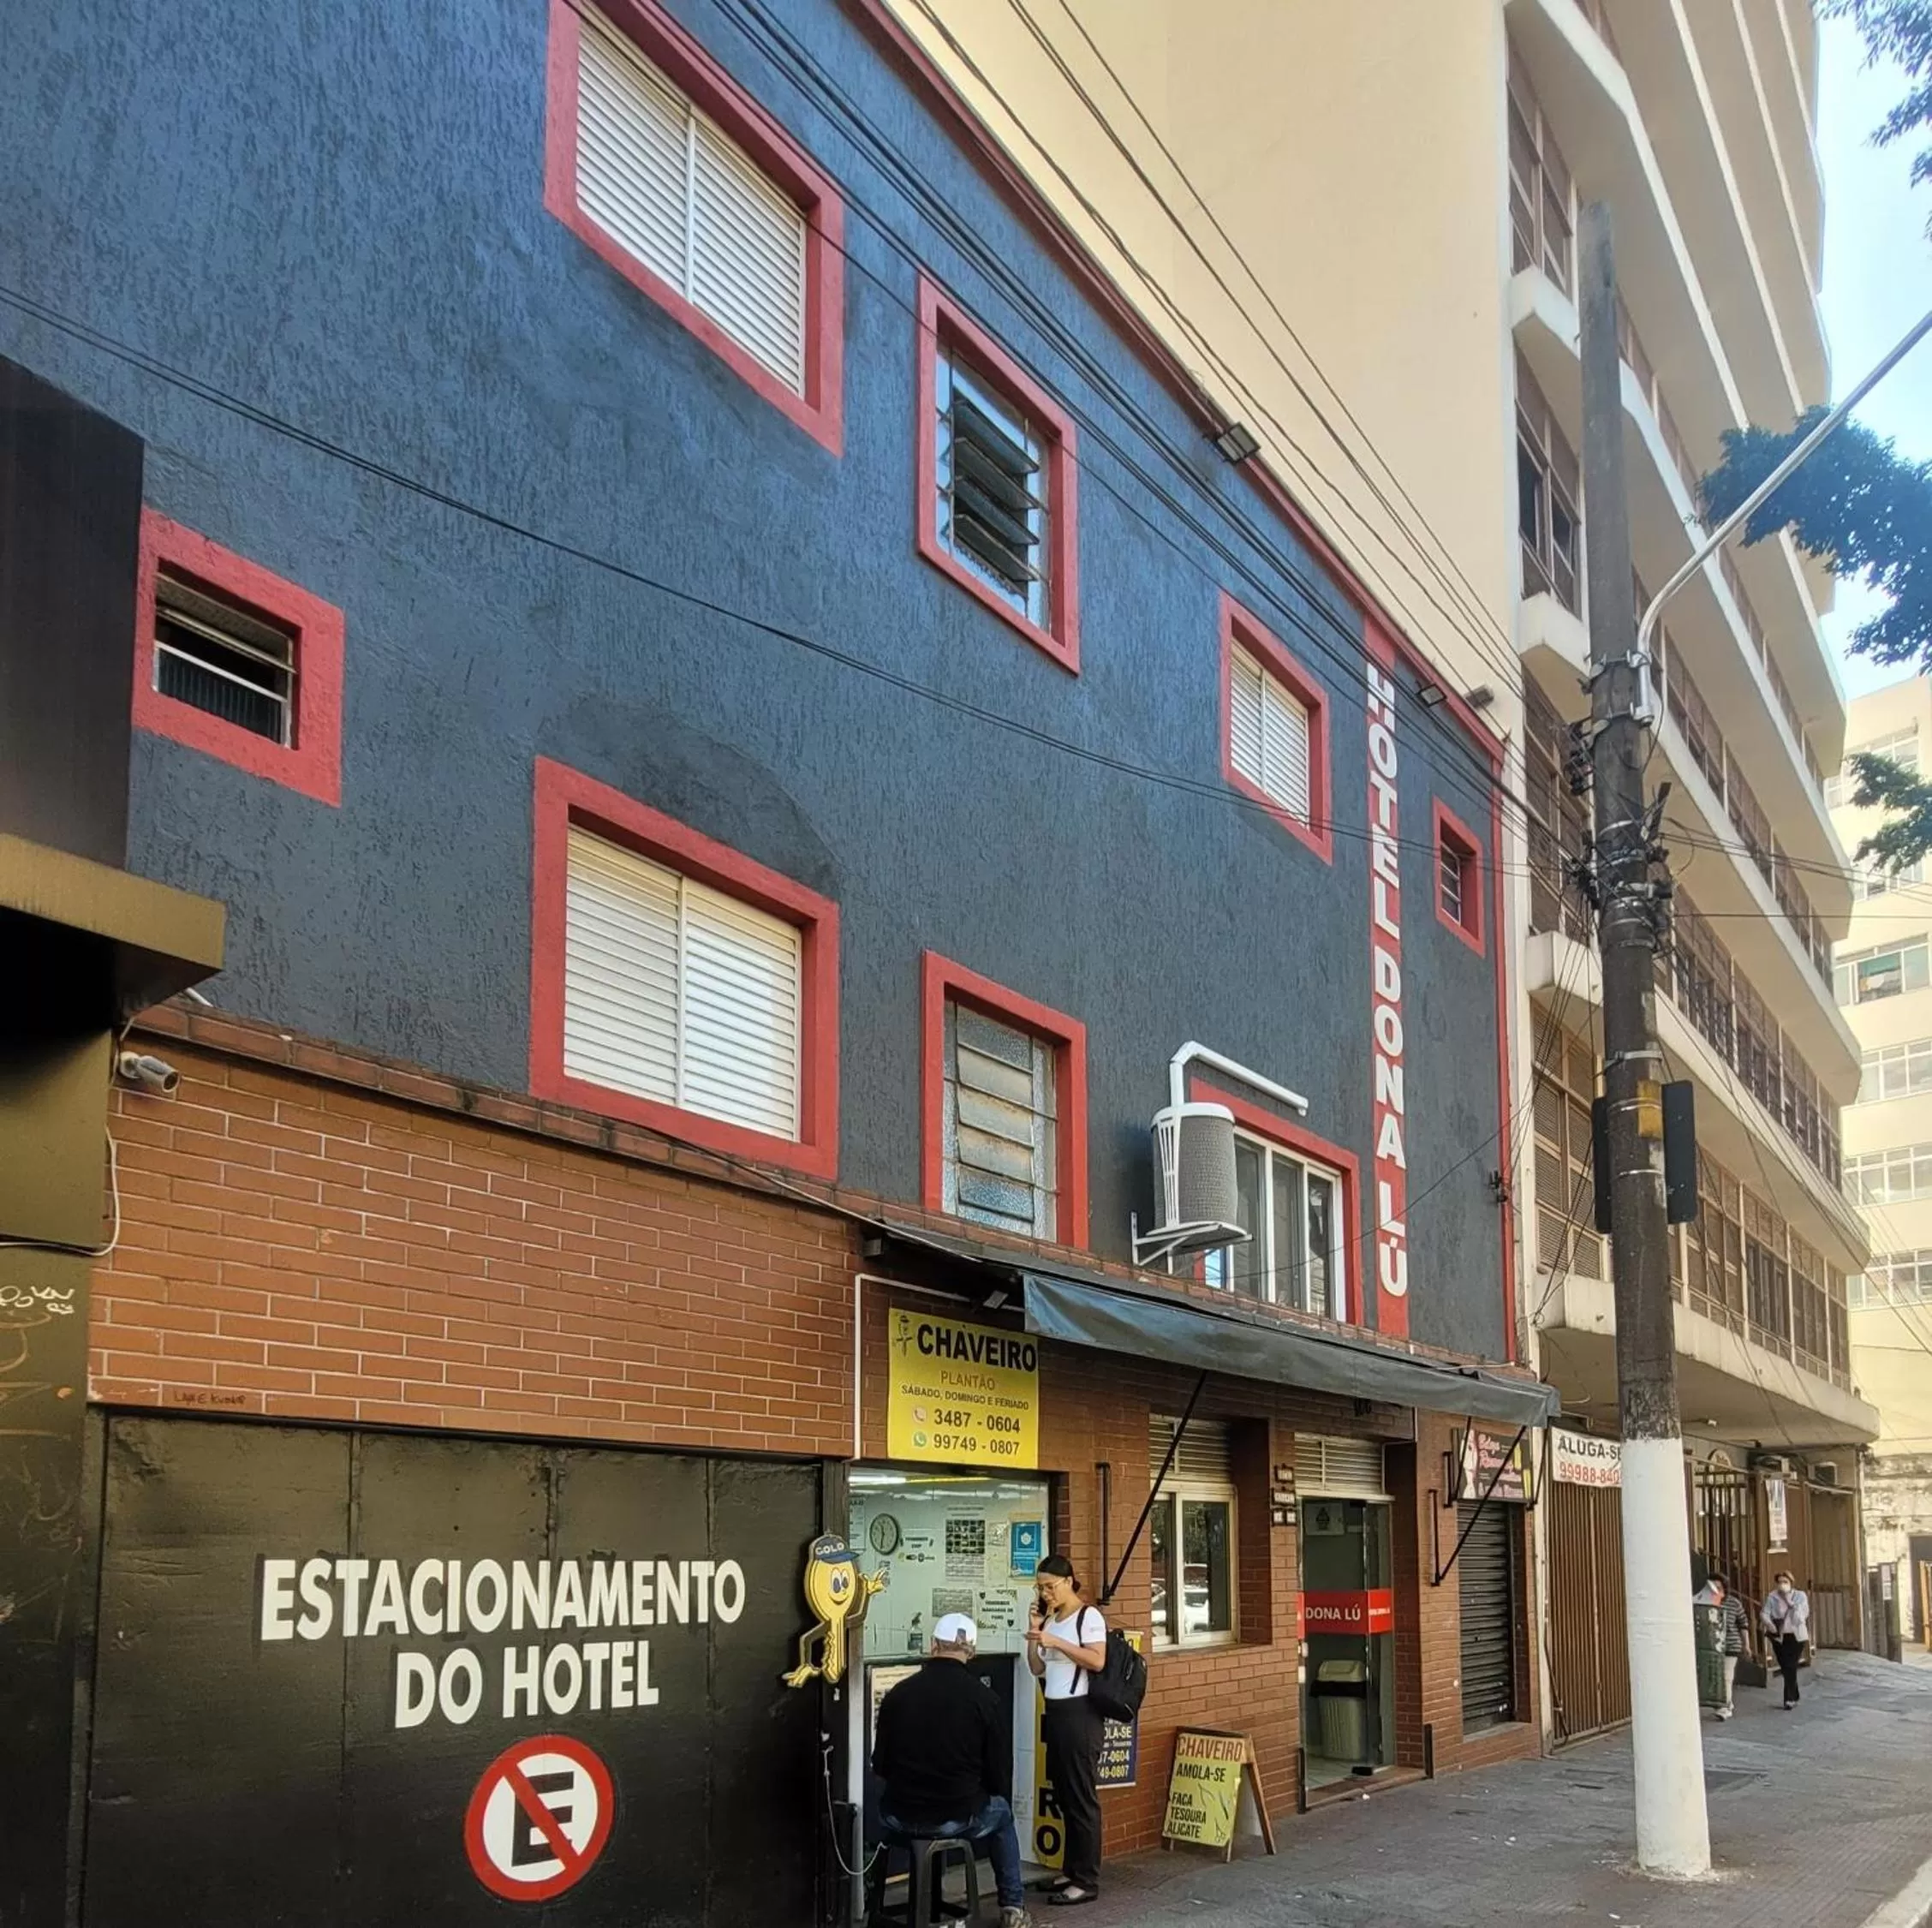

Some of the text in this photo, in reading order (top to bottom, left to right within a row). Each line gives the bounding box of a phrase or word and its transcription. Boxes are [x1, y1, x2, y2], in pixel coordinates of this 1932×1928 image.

[1367, 661, 1400, 940] HOTEL
[1374, 945, 1407, 1171] DONA
[917, 1323, 1037, 1373] CHAVEIRO
[945, 1390, 986, 1405] DOMINGO
[995, 1396, 1029, 1411] FERIADO
[934, 1408, 971, 1428] 3487
[987, 1415, 1021, 1434] 0604
[933, 1434, 976, 1452] 99749
[990, 1440, 1020, 1455] 0807
[1559, 1461, 1623, 1486] 99988-840
[261, 1559, 746, 1640] ESTACIONAMENTO
[1306, 1607, 1341, 1620] DONA
[1345, 1603, 1361, 1621] LÚ
[395, 1640, 659, 1728] DO HOTEL
[1177, 1736, 1243, 1762] CHAVEIRO
[1176, 1763, 1226, 1782] AMOLA-SE
[1172, 1792, 1192, 1806] FACA
[1171, 1806, 1207, 1824] TESOURA
[1166, 1821, 1202, 1839] ALICATE
